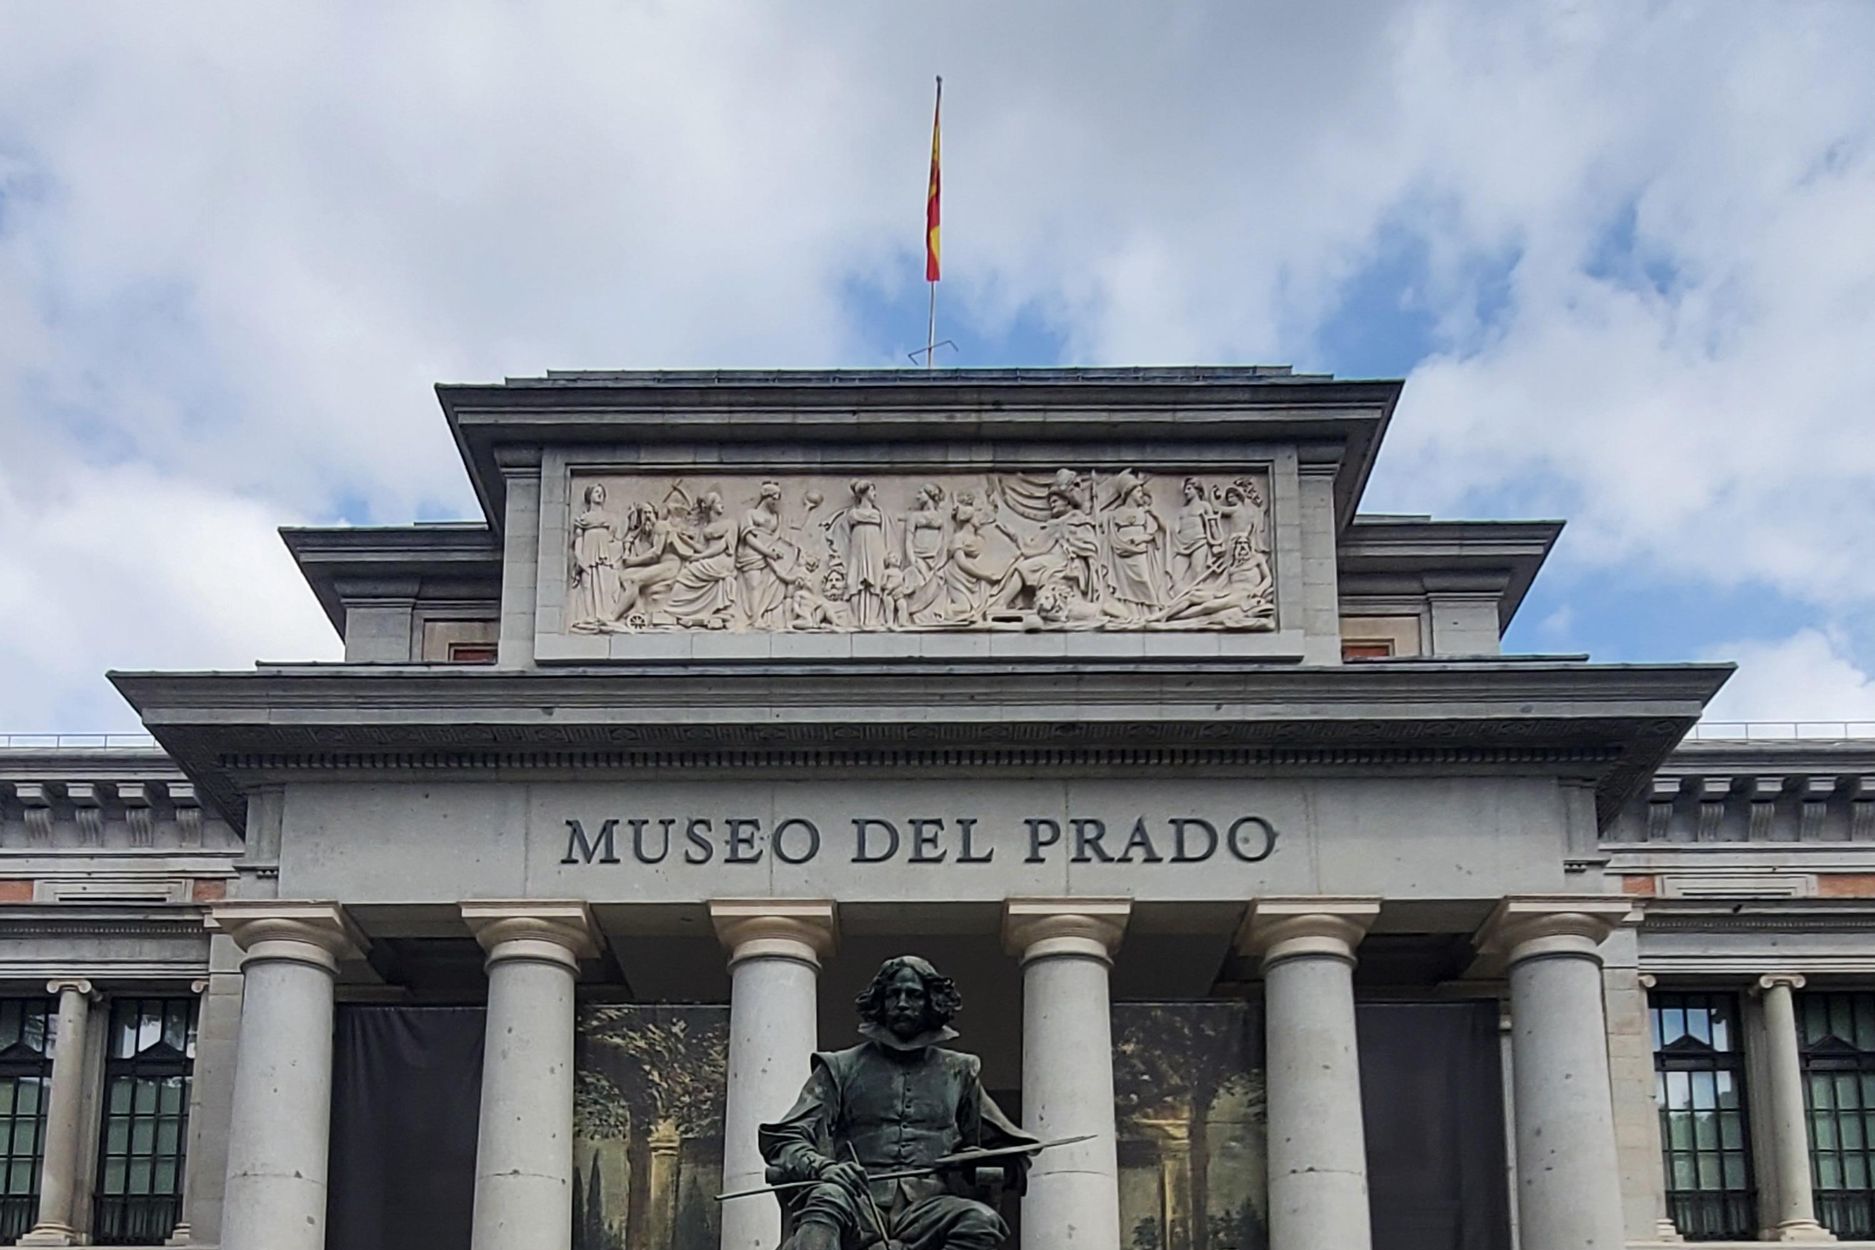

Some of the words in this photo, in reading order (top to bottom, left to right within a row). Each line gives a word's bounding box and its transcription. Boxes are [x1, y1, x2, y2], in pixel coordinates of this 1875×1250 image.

[560, 818, 821, 865] MUSEO
[850, 818, 995, 864] DEL
[1023, 816, 1277, 864] PRADO
